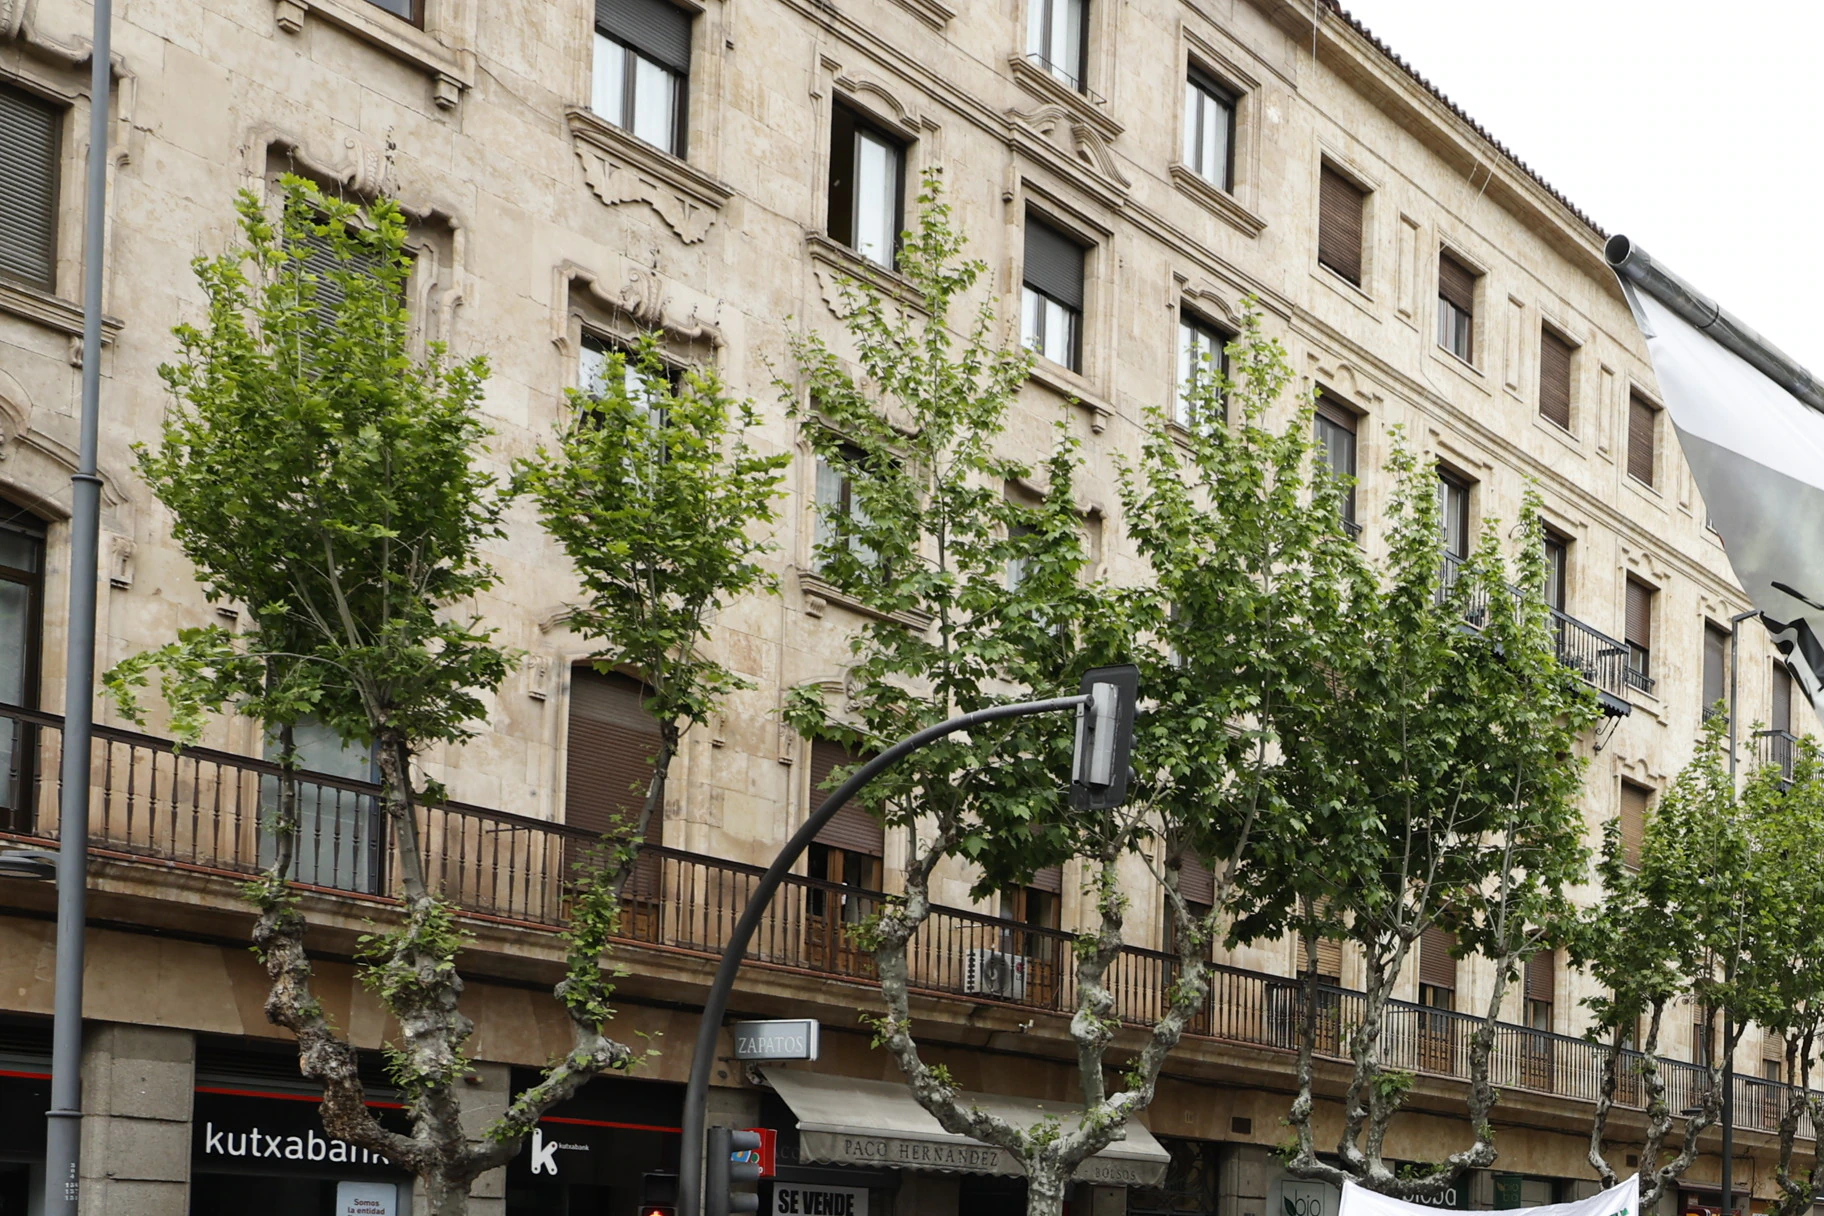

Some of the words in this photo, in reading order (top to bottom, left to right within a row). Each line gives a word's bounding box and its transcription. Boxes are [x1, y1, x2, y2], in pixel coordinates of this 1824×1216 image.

[738, 1036, 804, 1054] ZAPATOS
[844, 1139, 888, 1158] PACO
[1095, 1167, 1136, 1181] BOLSOS
[347, 1206, 356, 1214] la
[356, 1207, 386, 1215] entidad
[353, 1198, 380, 1207] Somos
[778, 1188, 799, 1214] SE
[802, 1190, 855, 1216] VENDE
[1294, 1188, 1321, 1216] bio
